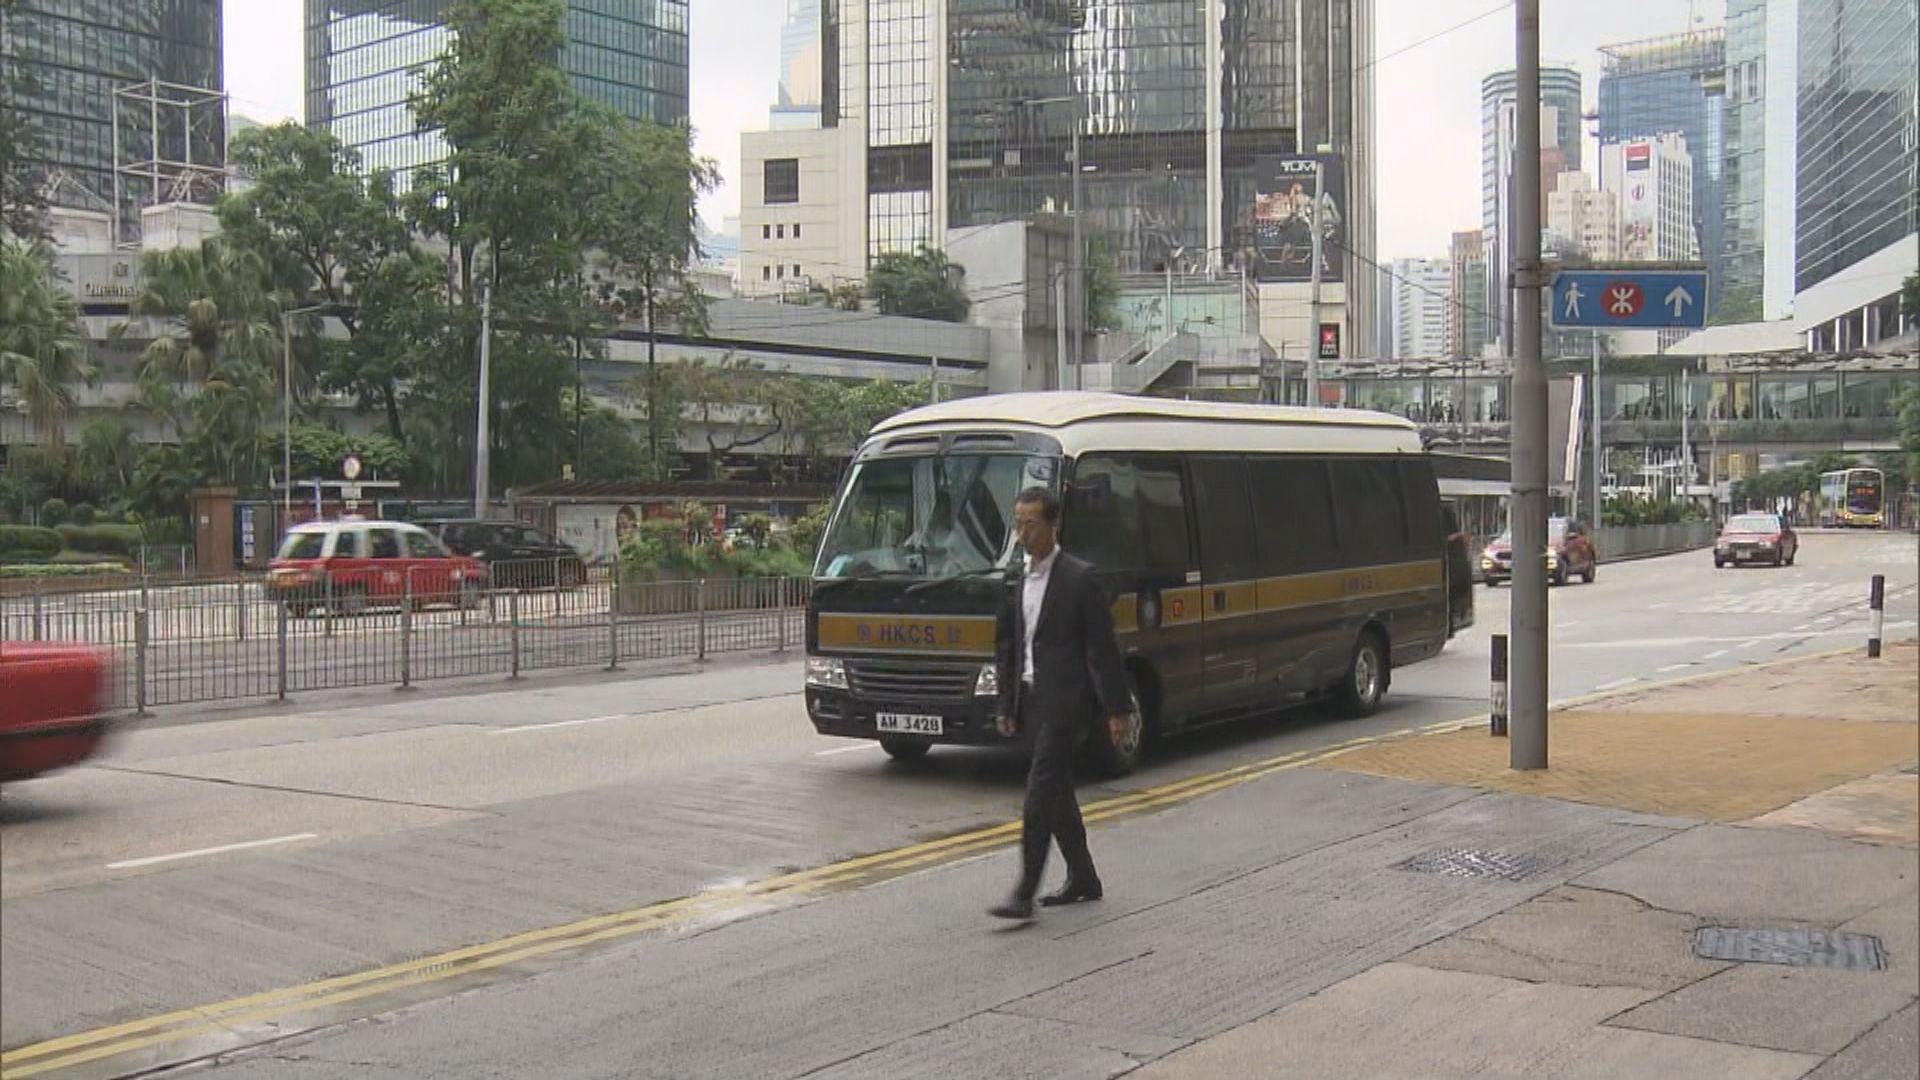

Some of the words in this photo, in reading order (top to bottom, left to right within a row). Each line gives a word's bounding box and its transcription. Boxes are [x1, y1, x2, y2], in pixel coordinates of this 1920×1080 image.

[1281, 160, 1317, 171] TUM
[880, 624, 936, 643] HKCS
[880, 715, 898, 728] AM
